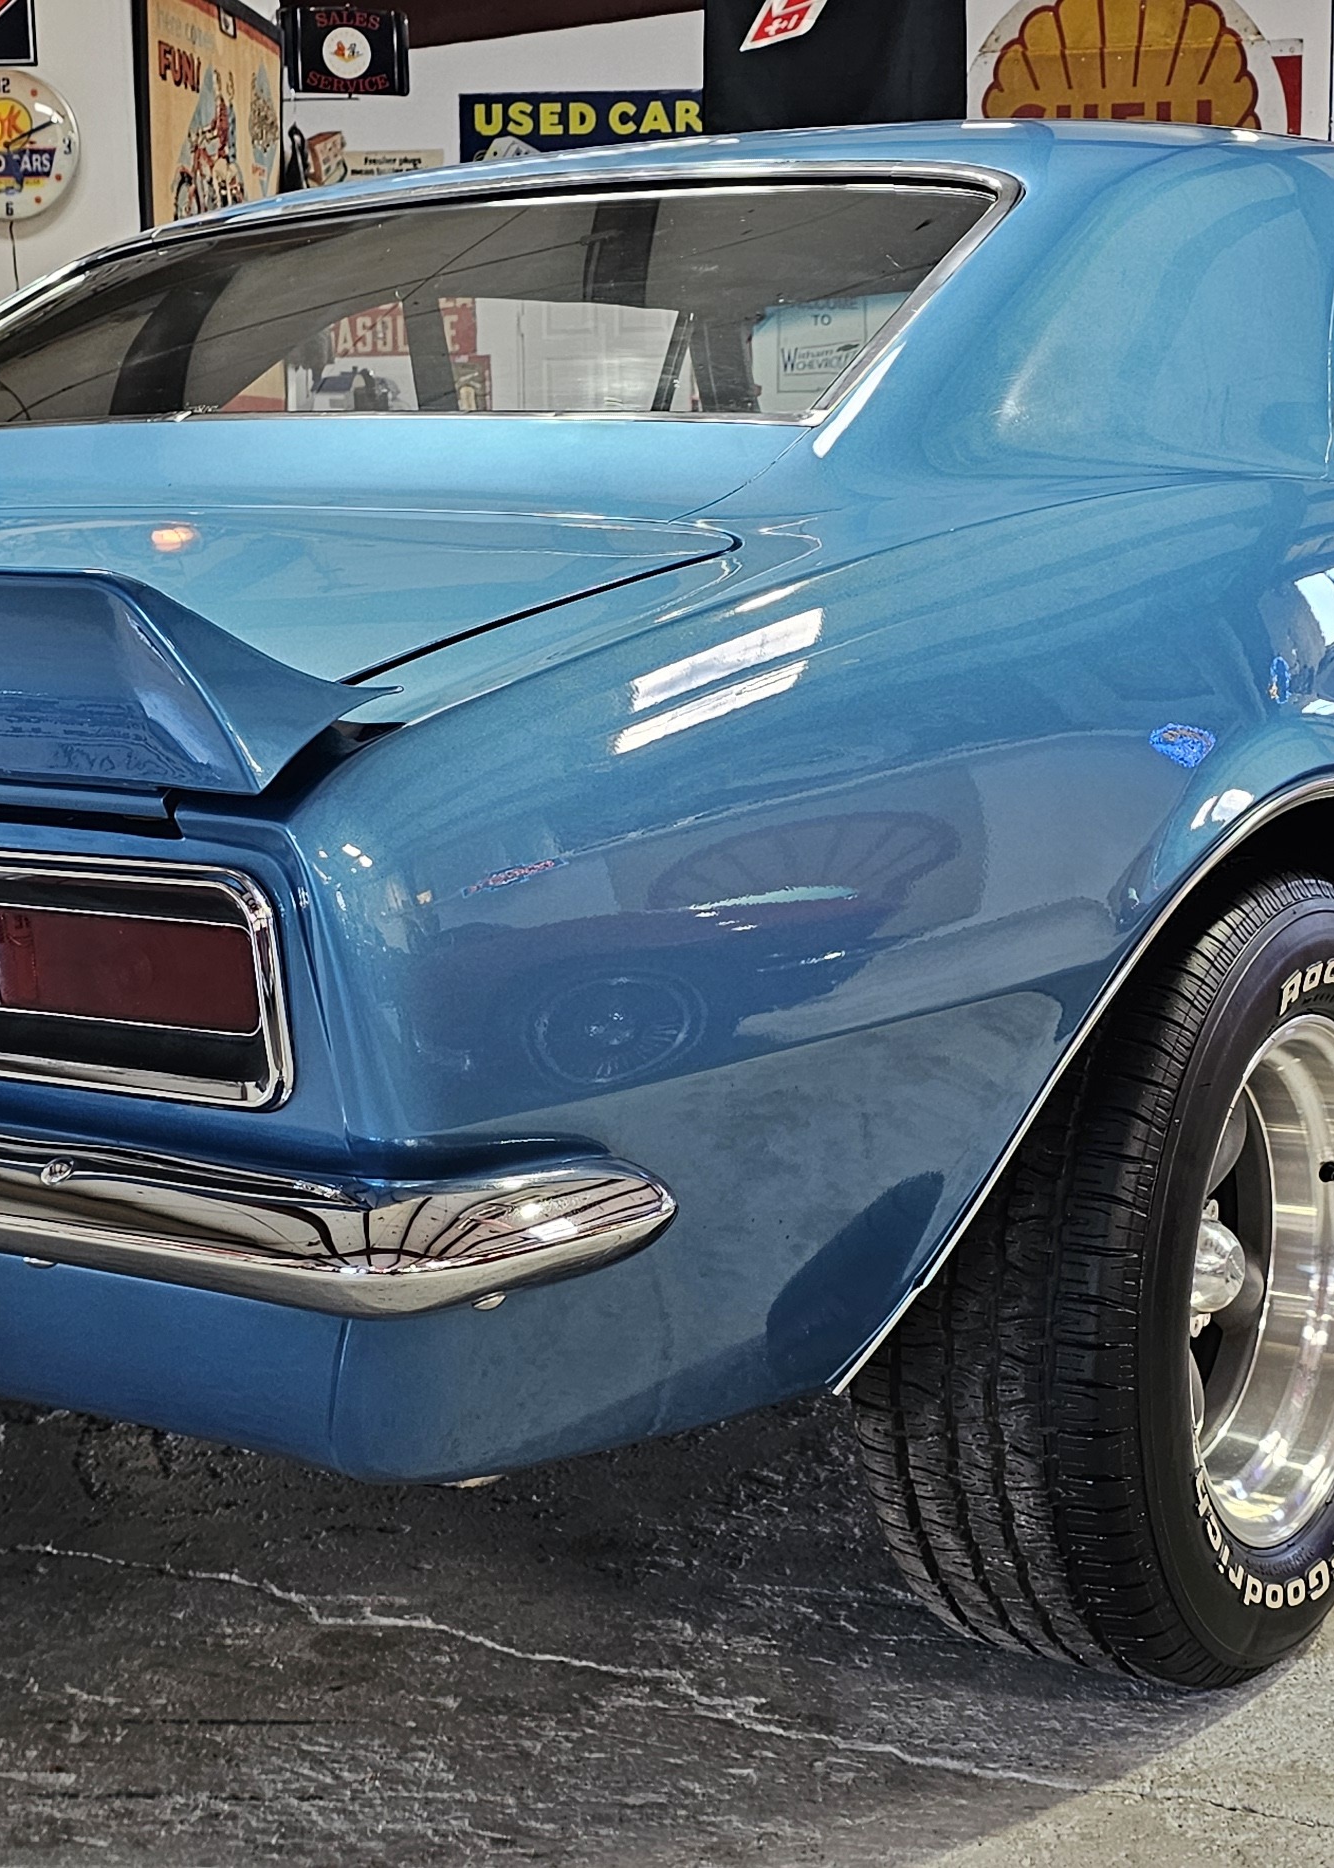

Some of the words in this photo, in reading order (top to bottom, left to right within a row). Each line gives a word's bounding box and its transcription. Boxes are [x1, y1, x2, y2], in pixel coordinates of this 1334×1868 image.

[315, 10, 381, 30] SALES
[158, 40, 201, 94] FUN!
[306, 70, 390, 93] SERVICE
[474, 101, 597, 136] USED
[63, 136, 72, 155] 3
[13, 153, 51, 172] ARS
[5, 202, 14, 216] 6
[813, 314, 832, 326] TO
